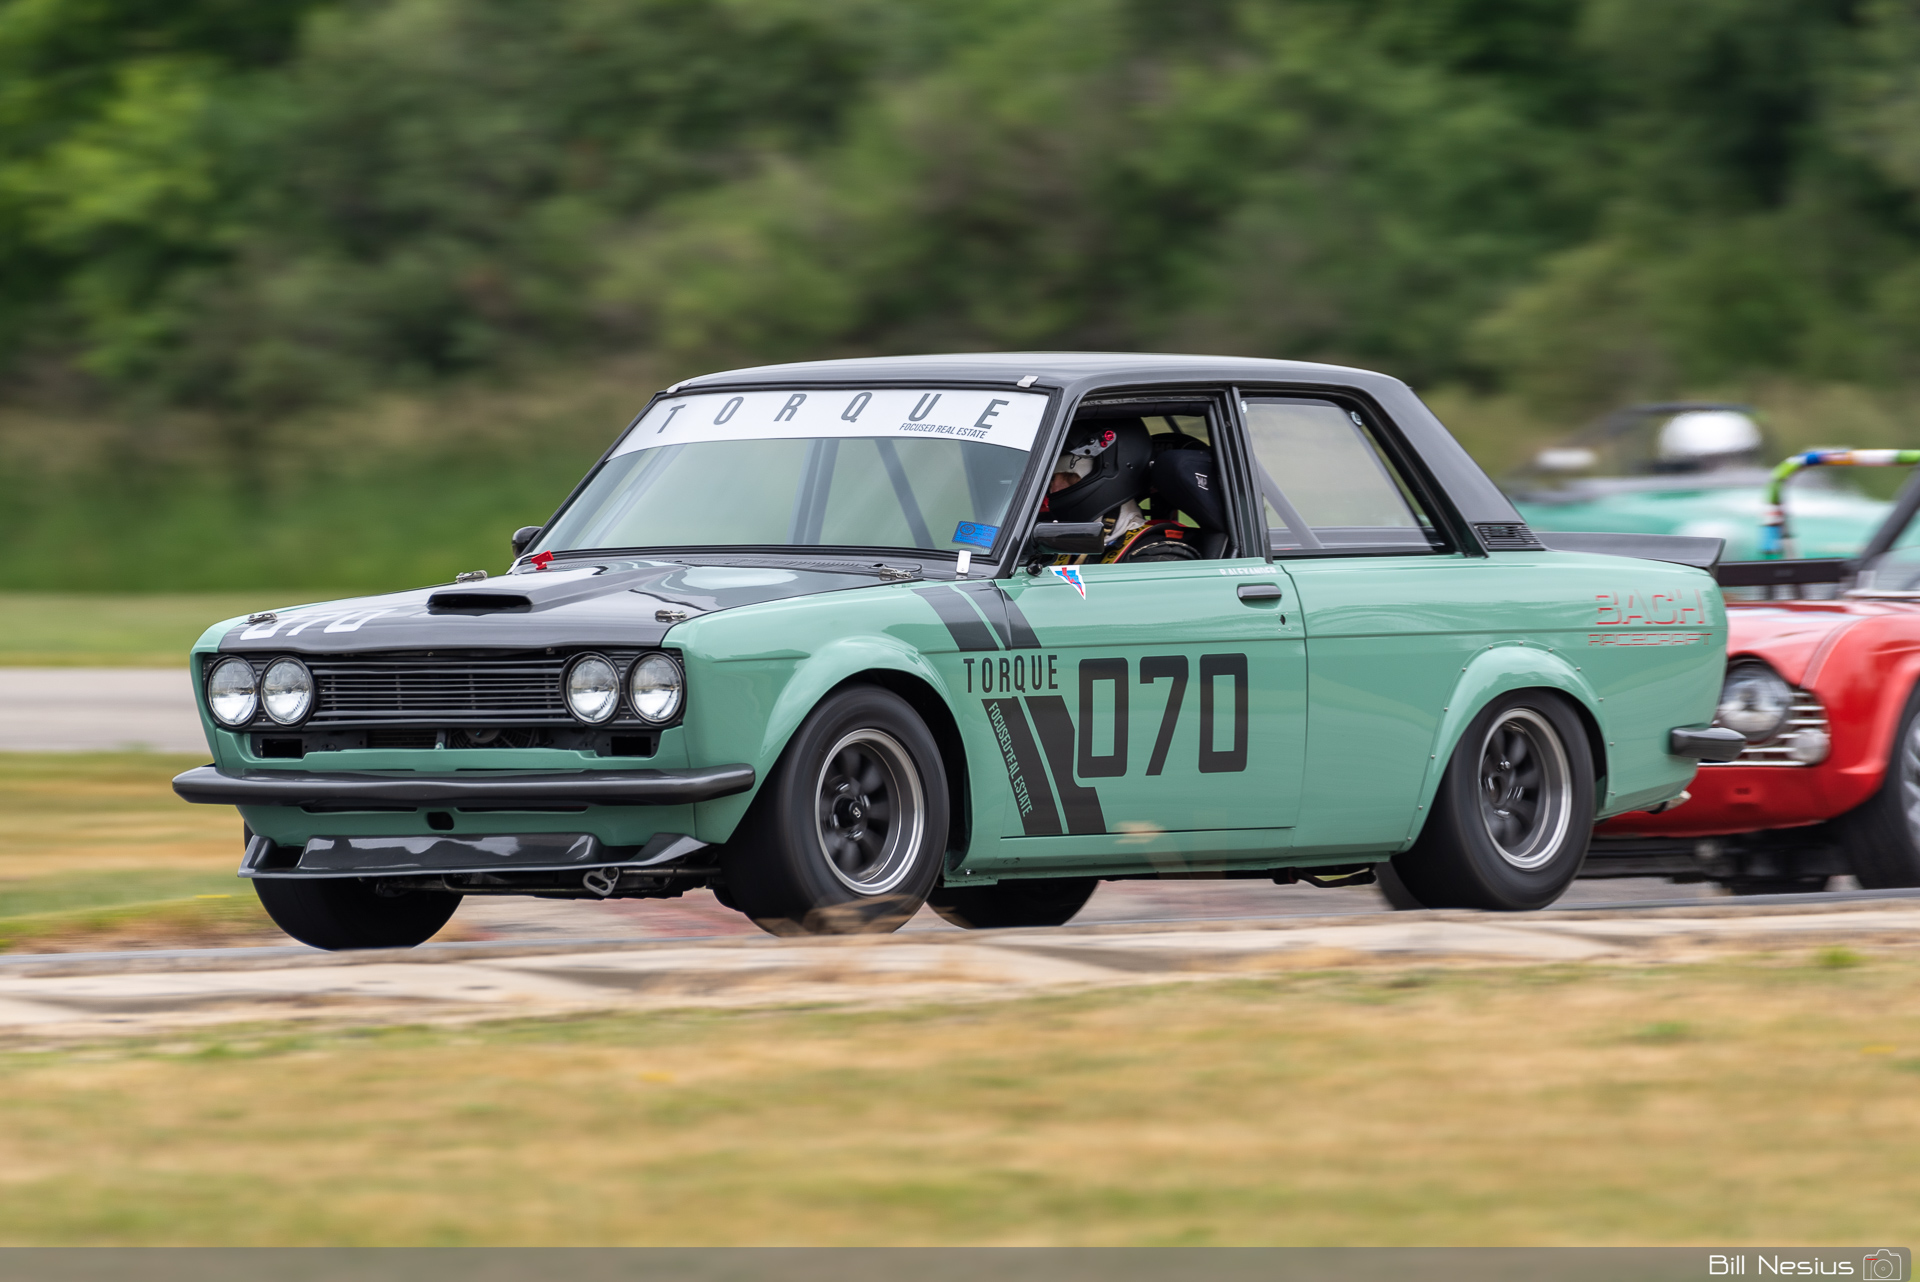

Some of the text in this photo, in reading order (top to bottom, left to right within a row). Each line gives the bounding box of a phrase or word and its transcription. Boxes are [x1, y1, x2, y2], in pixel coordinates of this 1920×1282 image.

[657, 392, 1009, 434] TORQUE
[899, 423, 988, 439] FOCUSED REAL ESTATE
[240, 608, 398, 641] 070
[1595, 589, 1705, 625] BACH
[1588, 633, 1713, 646] RACECRAFT
[963, 655, 1058, 694] TORQUE
[1077, 653, 1248, 778] 070
[988, 702, 1013, 752] FOCUSED
[1013, 775, 1033, 817] ESTATE
